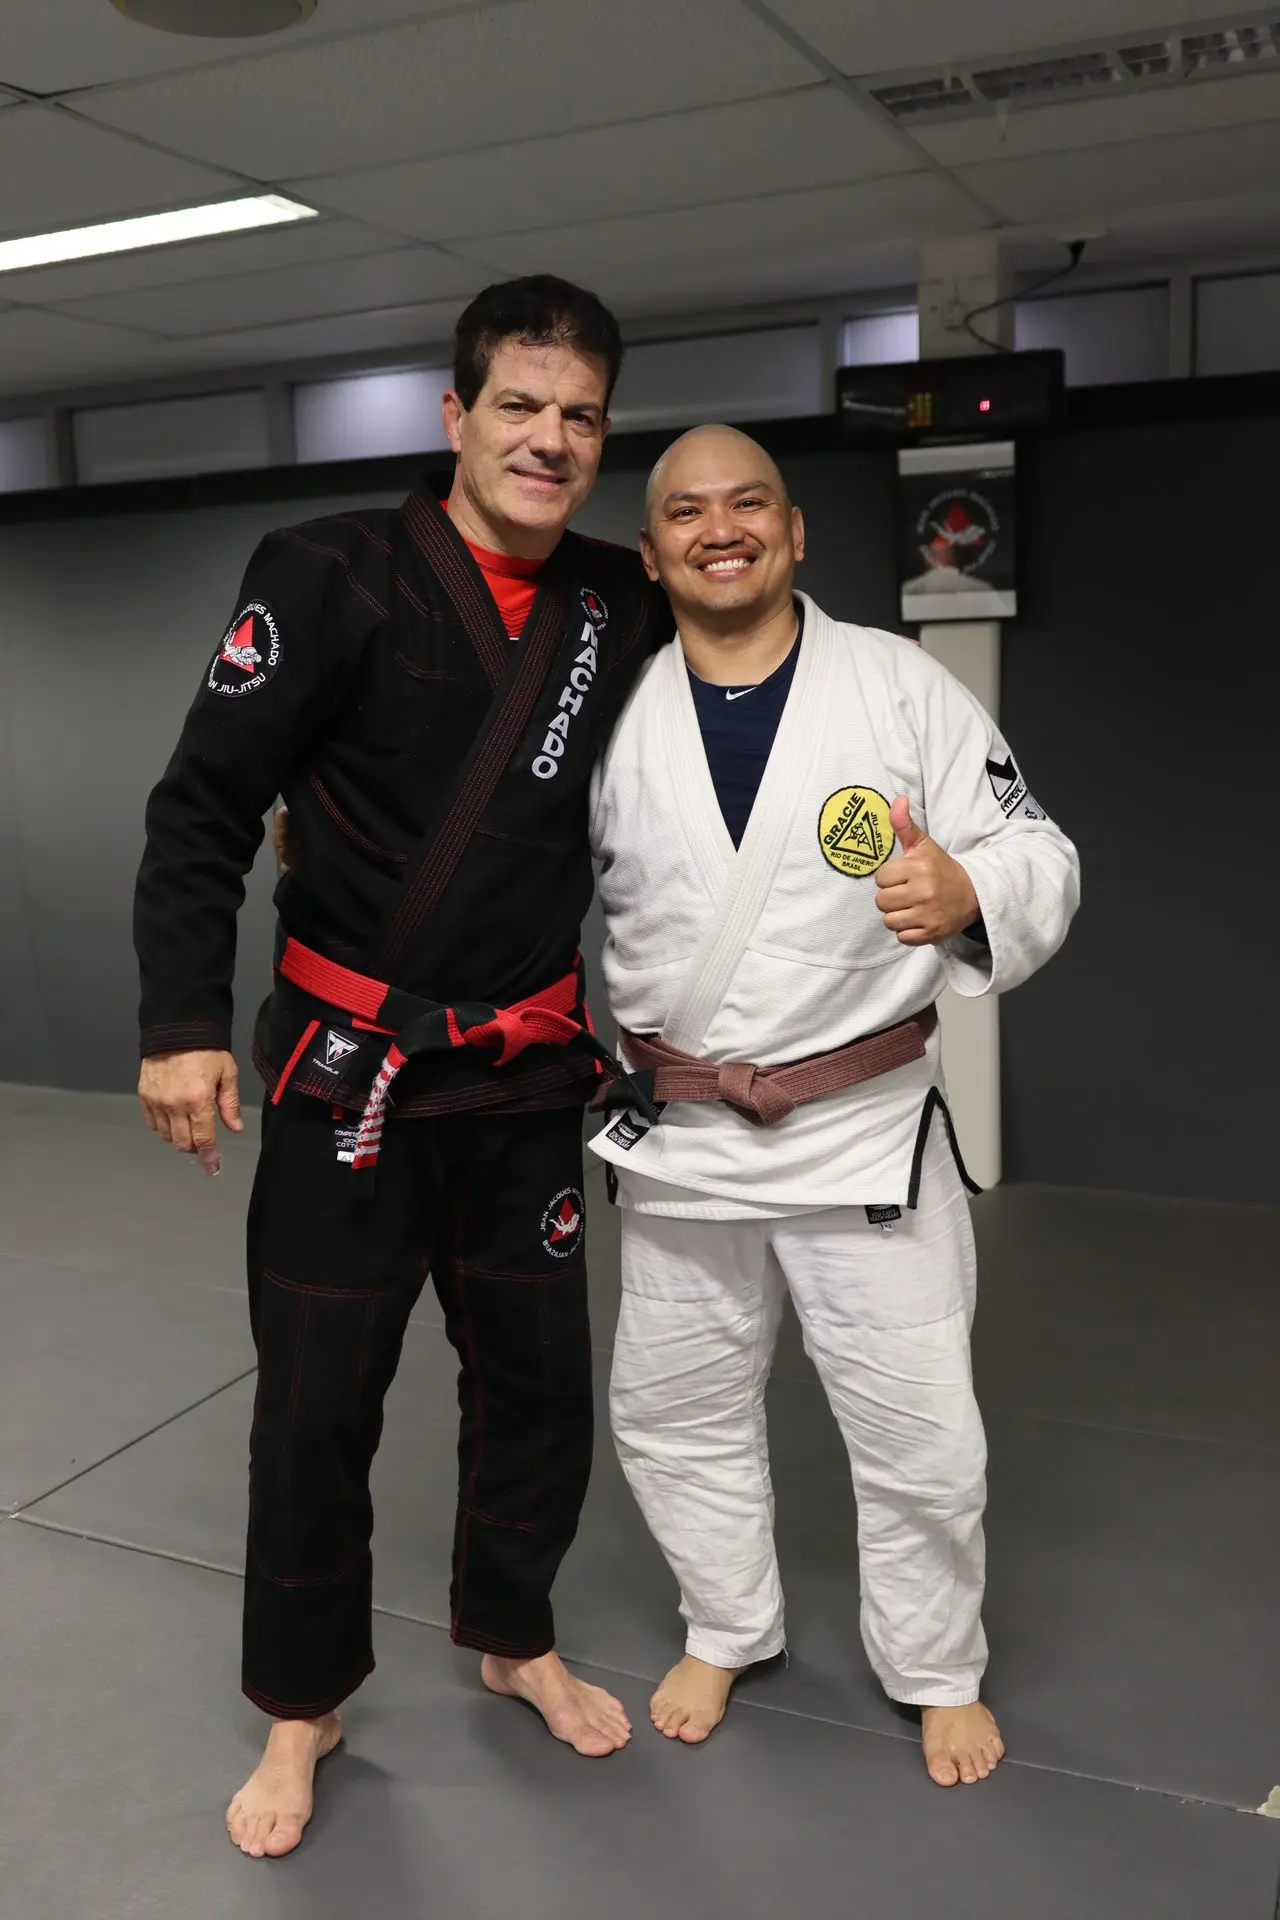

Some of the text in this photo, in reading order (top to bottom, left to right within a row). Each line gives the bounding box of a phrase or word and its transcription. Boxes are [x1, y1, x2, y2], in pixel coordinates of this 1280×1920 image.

[263, 612, 280, 666] MACHADO
[217, 672, 266, 694] JIU-JITSU
[531, 622, 599, 780] MACHADO
[823, 792, 861, 845] GRACIE
[871, 811, 884, 857] JIU-JITSU
[830, 851, 875, 867] RIO DE JANEIRO
[841, 861, 861, 872] BRASIL
[540, 1211, 549, 1232] JEAN
[548, 1187, 572, 1211] JACQUES
